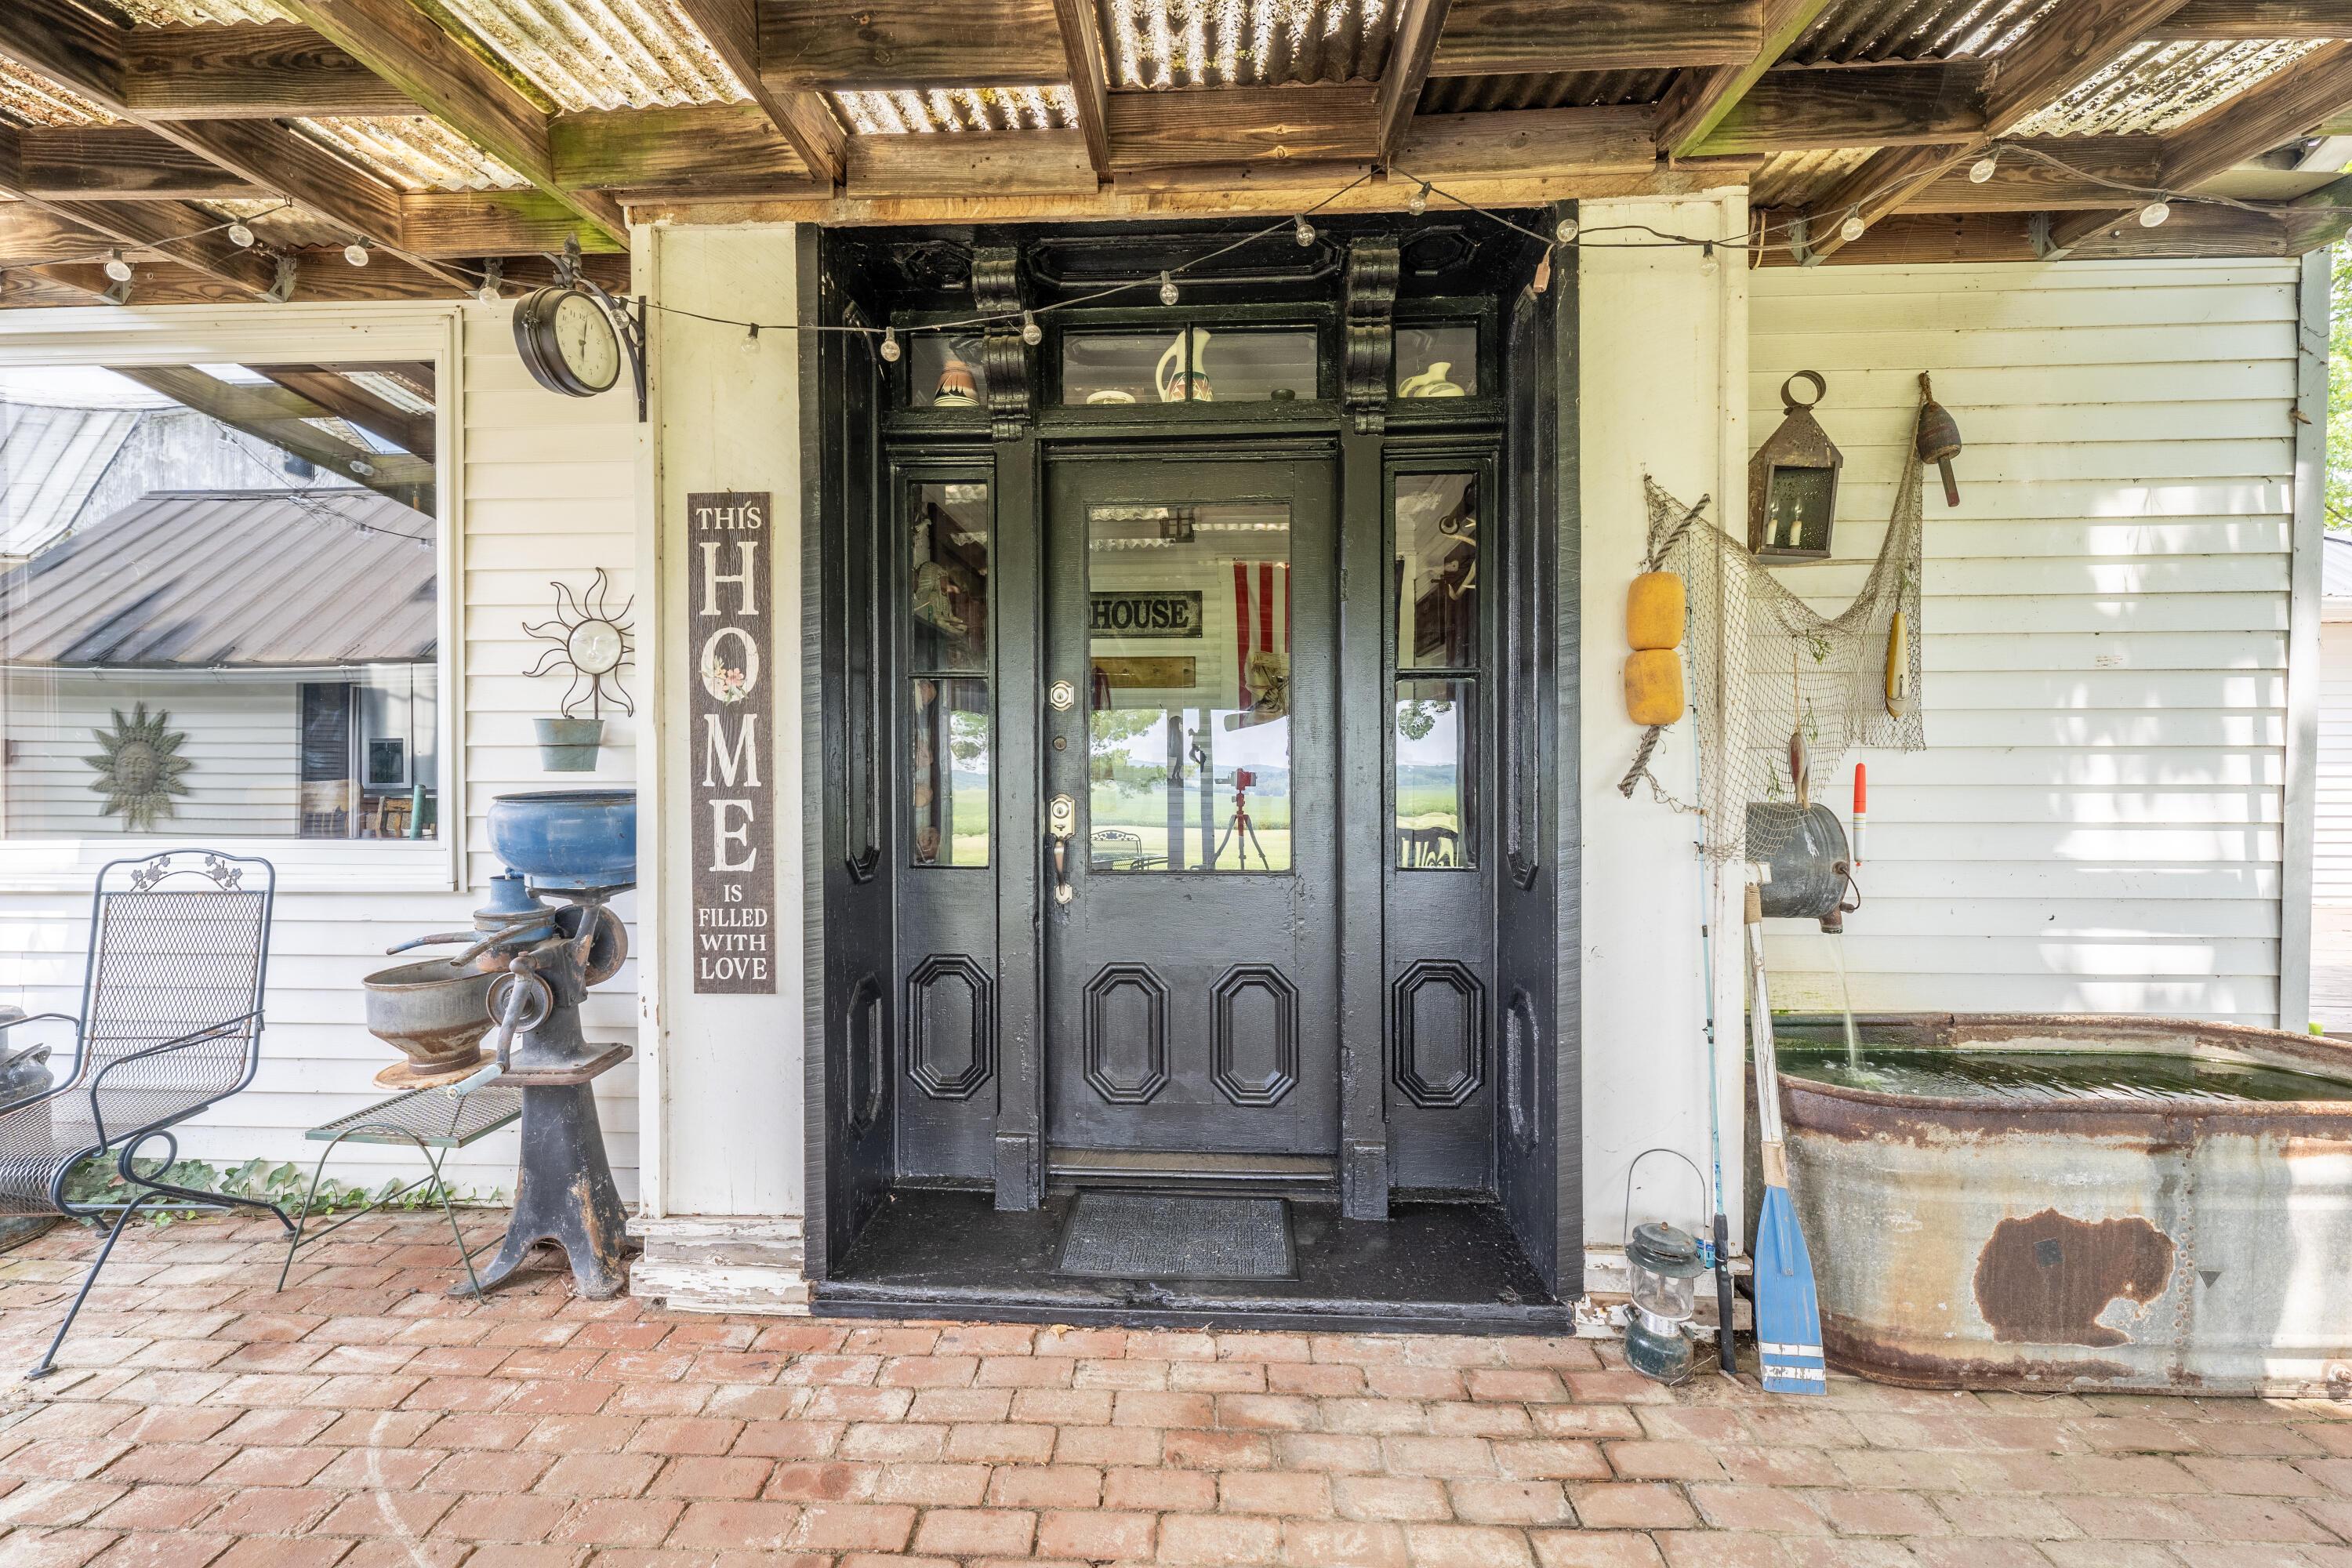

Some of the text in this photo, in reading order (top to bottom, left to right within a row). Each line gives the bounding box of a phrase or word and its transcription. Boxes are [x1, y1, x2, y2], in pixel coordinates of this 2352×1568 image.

[696, 506, 762, 529] THIS
[1091, 600, 1189, 629] HOUSE
[699, 541, 762, 873] HOME
[724, 884, 742, 902] IS
[699, 908, 768, 927] FILLED
[700, 934, 767, 951] WITH
[701, 956, 768, 980] LOVE
